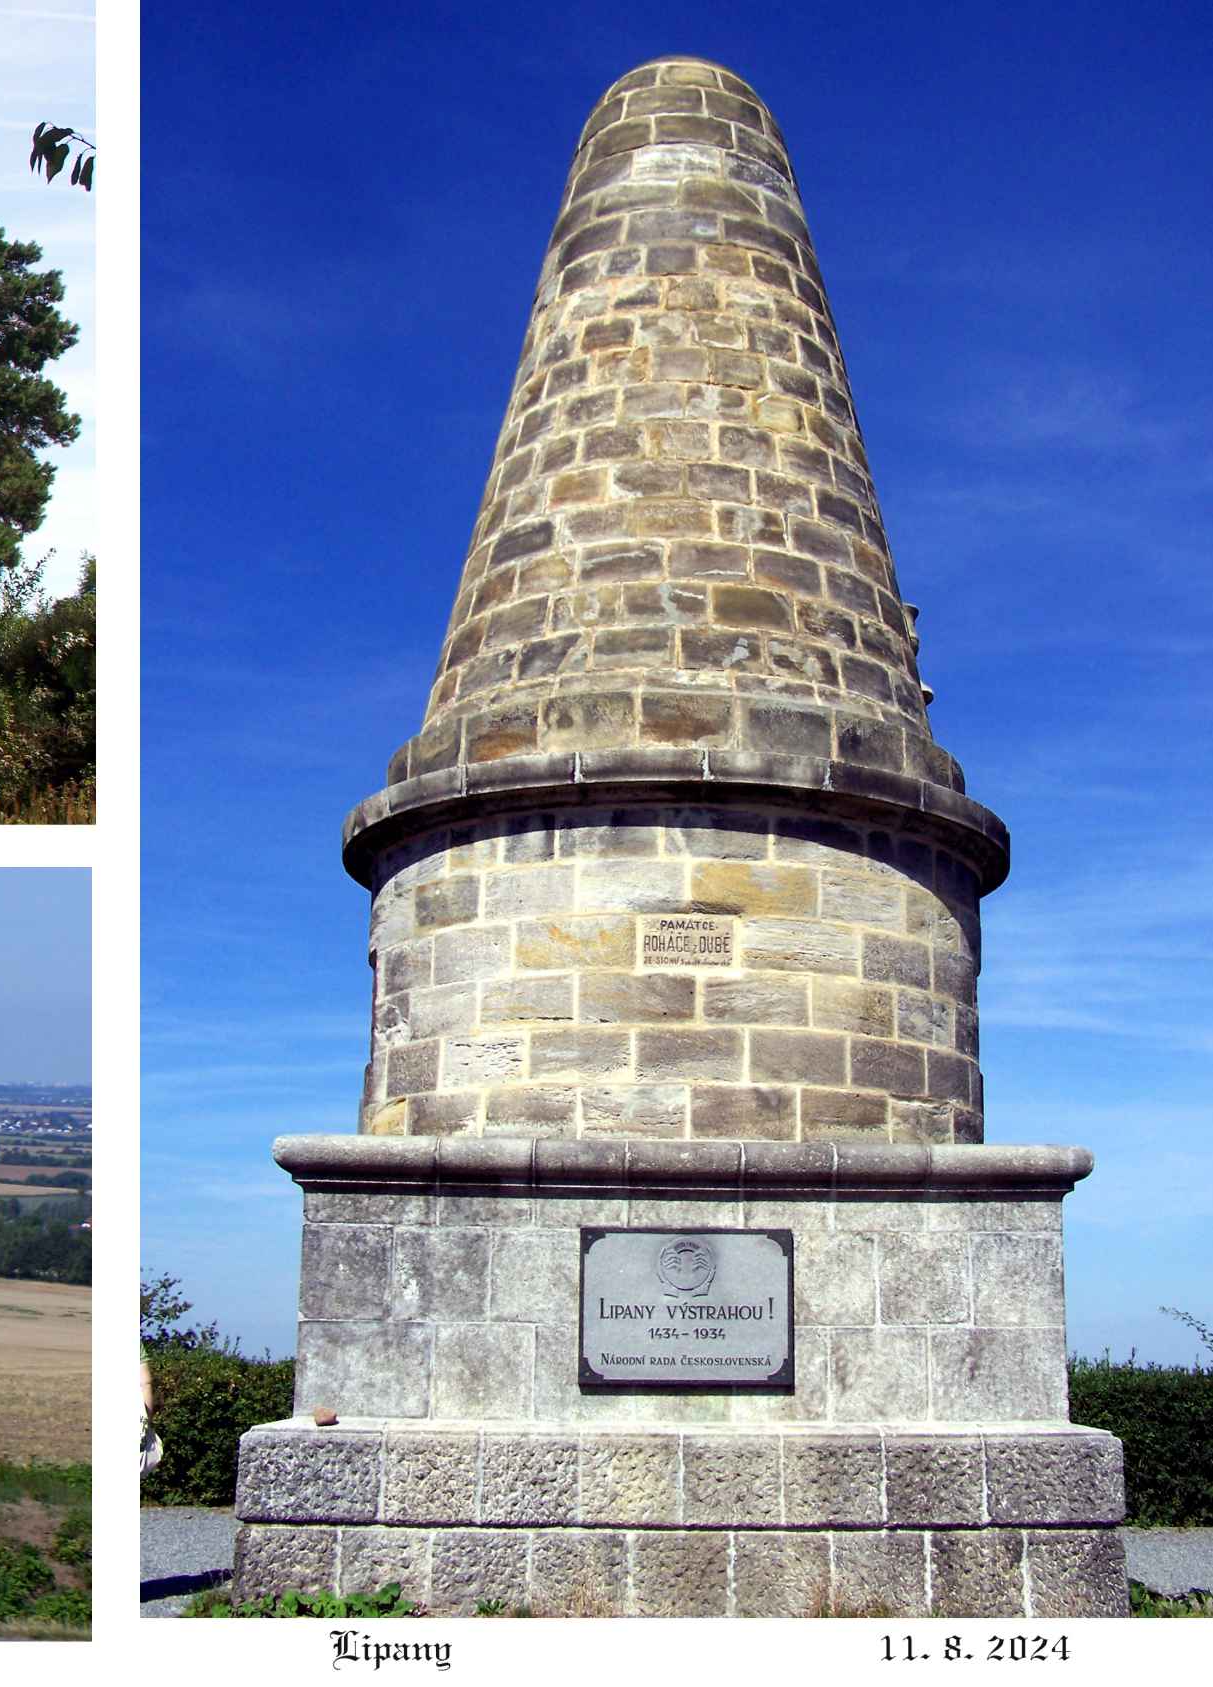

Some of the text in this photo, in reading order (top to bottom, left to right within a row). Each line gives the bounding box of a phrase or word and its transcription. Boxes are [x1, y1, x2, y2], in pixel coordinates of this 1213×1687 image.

[599, 1298, 655, 1320] LIPANY
[601, 1352, 771, 1367] NÁRODNÍ RADA ČESKOSLOVENSKÁ
